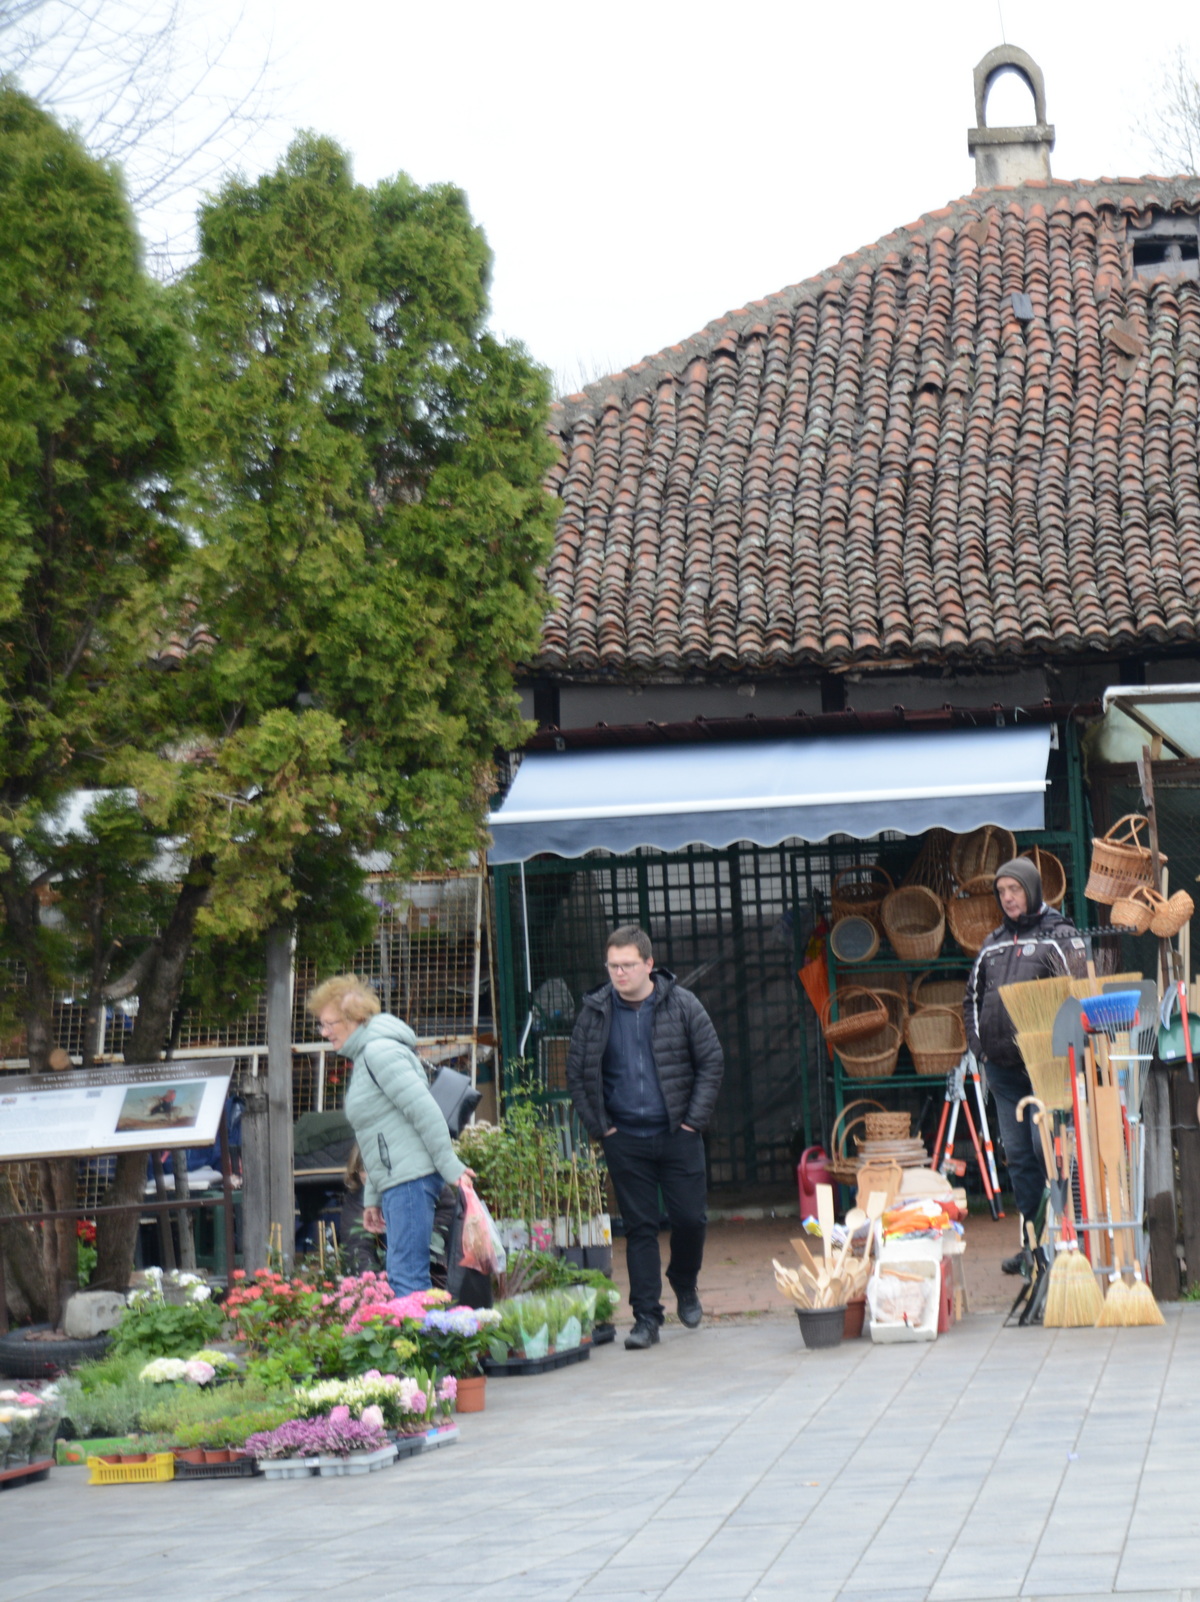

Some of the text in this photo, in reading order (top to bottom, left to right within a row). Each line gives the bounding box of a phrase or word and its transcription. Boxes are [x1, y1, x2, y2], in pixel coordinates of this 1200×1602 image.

[16, 1082, 75, 1092] ARCHITECTURE
[89, 1078, 102, 1086] THE
[105, 1077, 137, 1085] CAPITAL
[140, 1073, 157, 1081] CITY
[160, 1069, 211, 1079] KRAGUJEVAC
